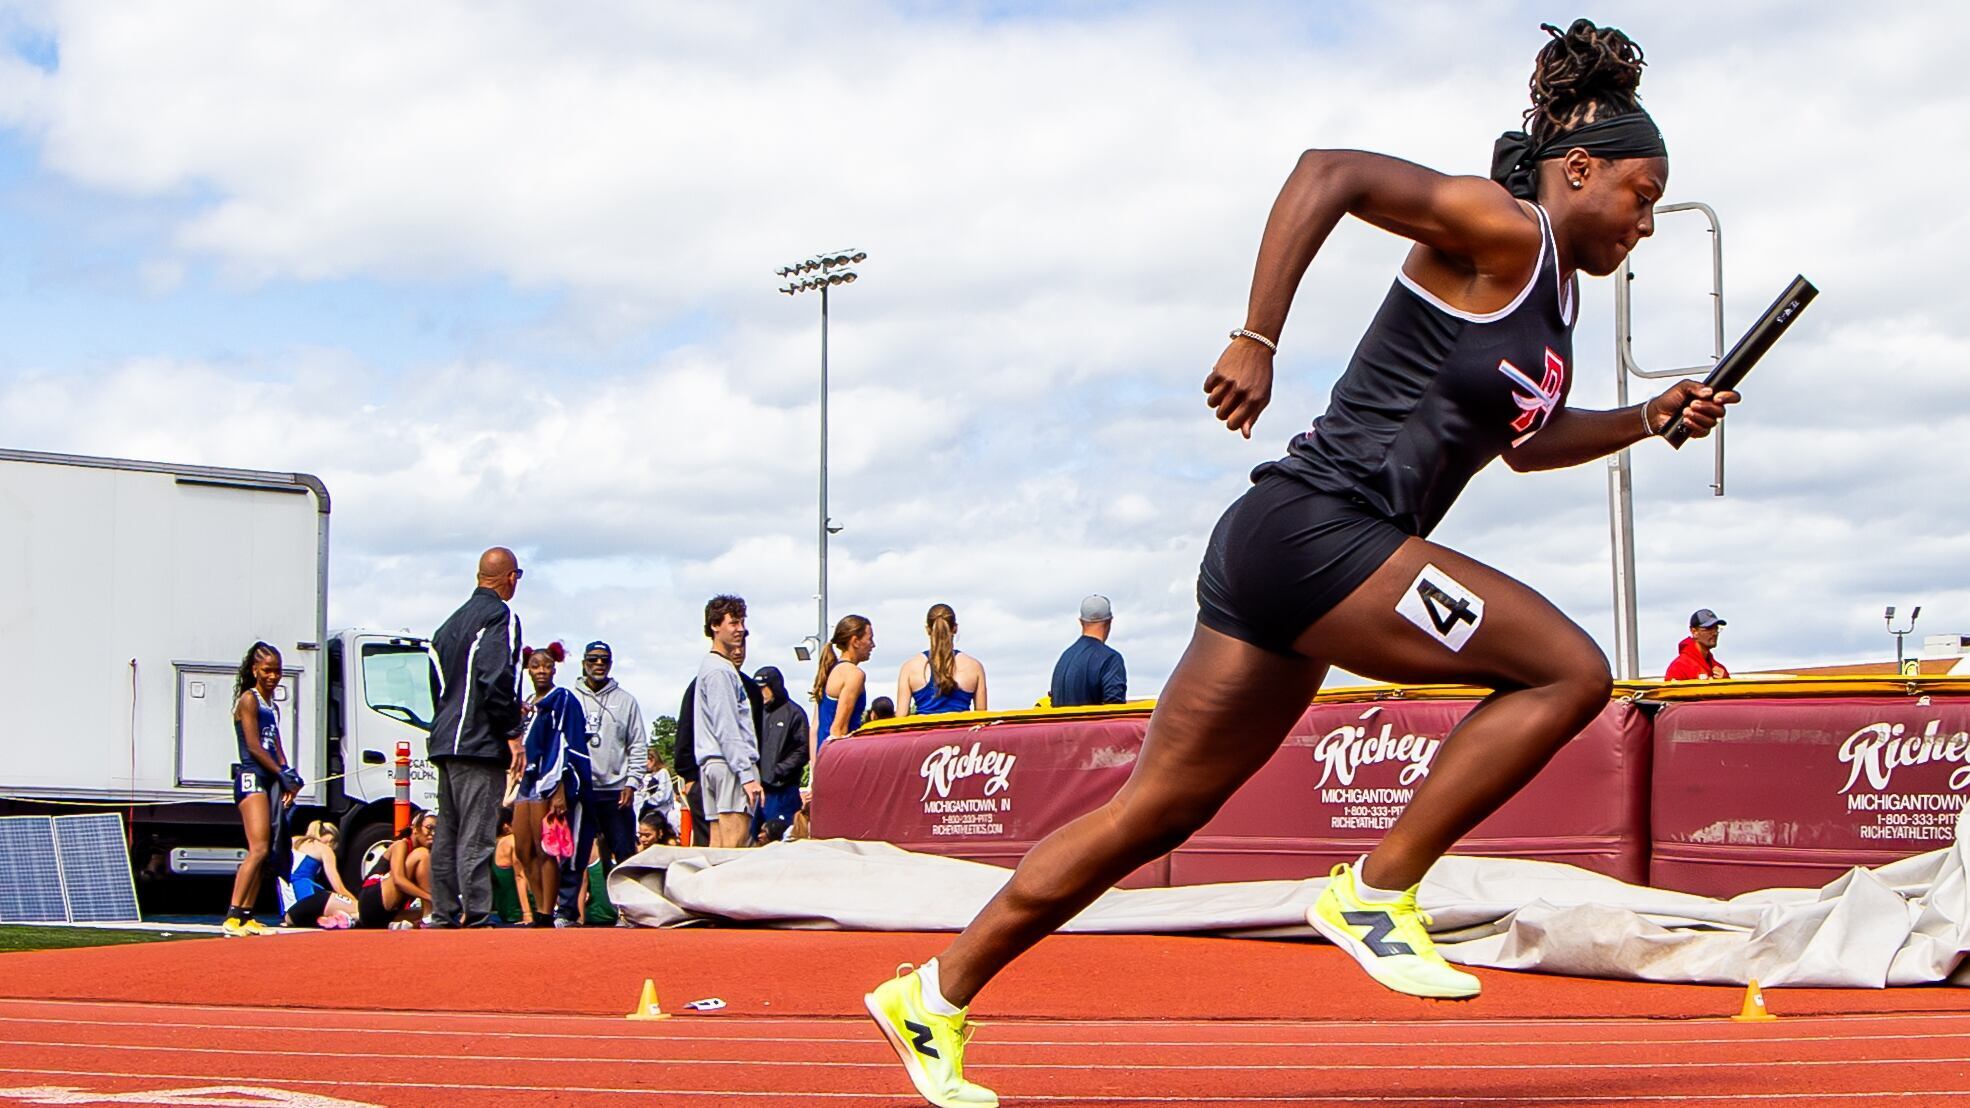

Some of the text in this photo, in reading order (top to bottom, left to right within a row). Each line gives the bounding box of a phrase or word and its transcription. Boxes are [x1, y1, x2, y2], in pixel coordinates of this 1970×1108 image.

[1416, 577, 1478, 635] 4
[1313, 723, 1440, 790] Richey
[919, 742, 1016, 801] Richey
[244, 774, 253, 790] 5
[924, 798, 1011, 814] MICHIGANTOWN, IN
[1343, 805, 1405, 816] 1-800-333-PIT
[1847, 794, 1967, 811] MICHIGANTOWN
[1331, 817, 1397, 829] RICHEYATHLETIC
[1860, 825, 1955, 840] RICHEYATHLETICS.
